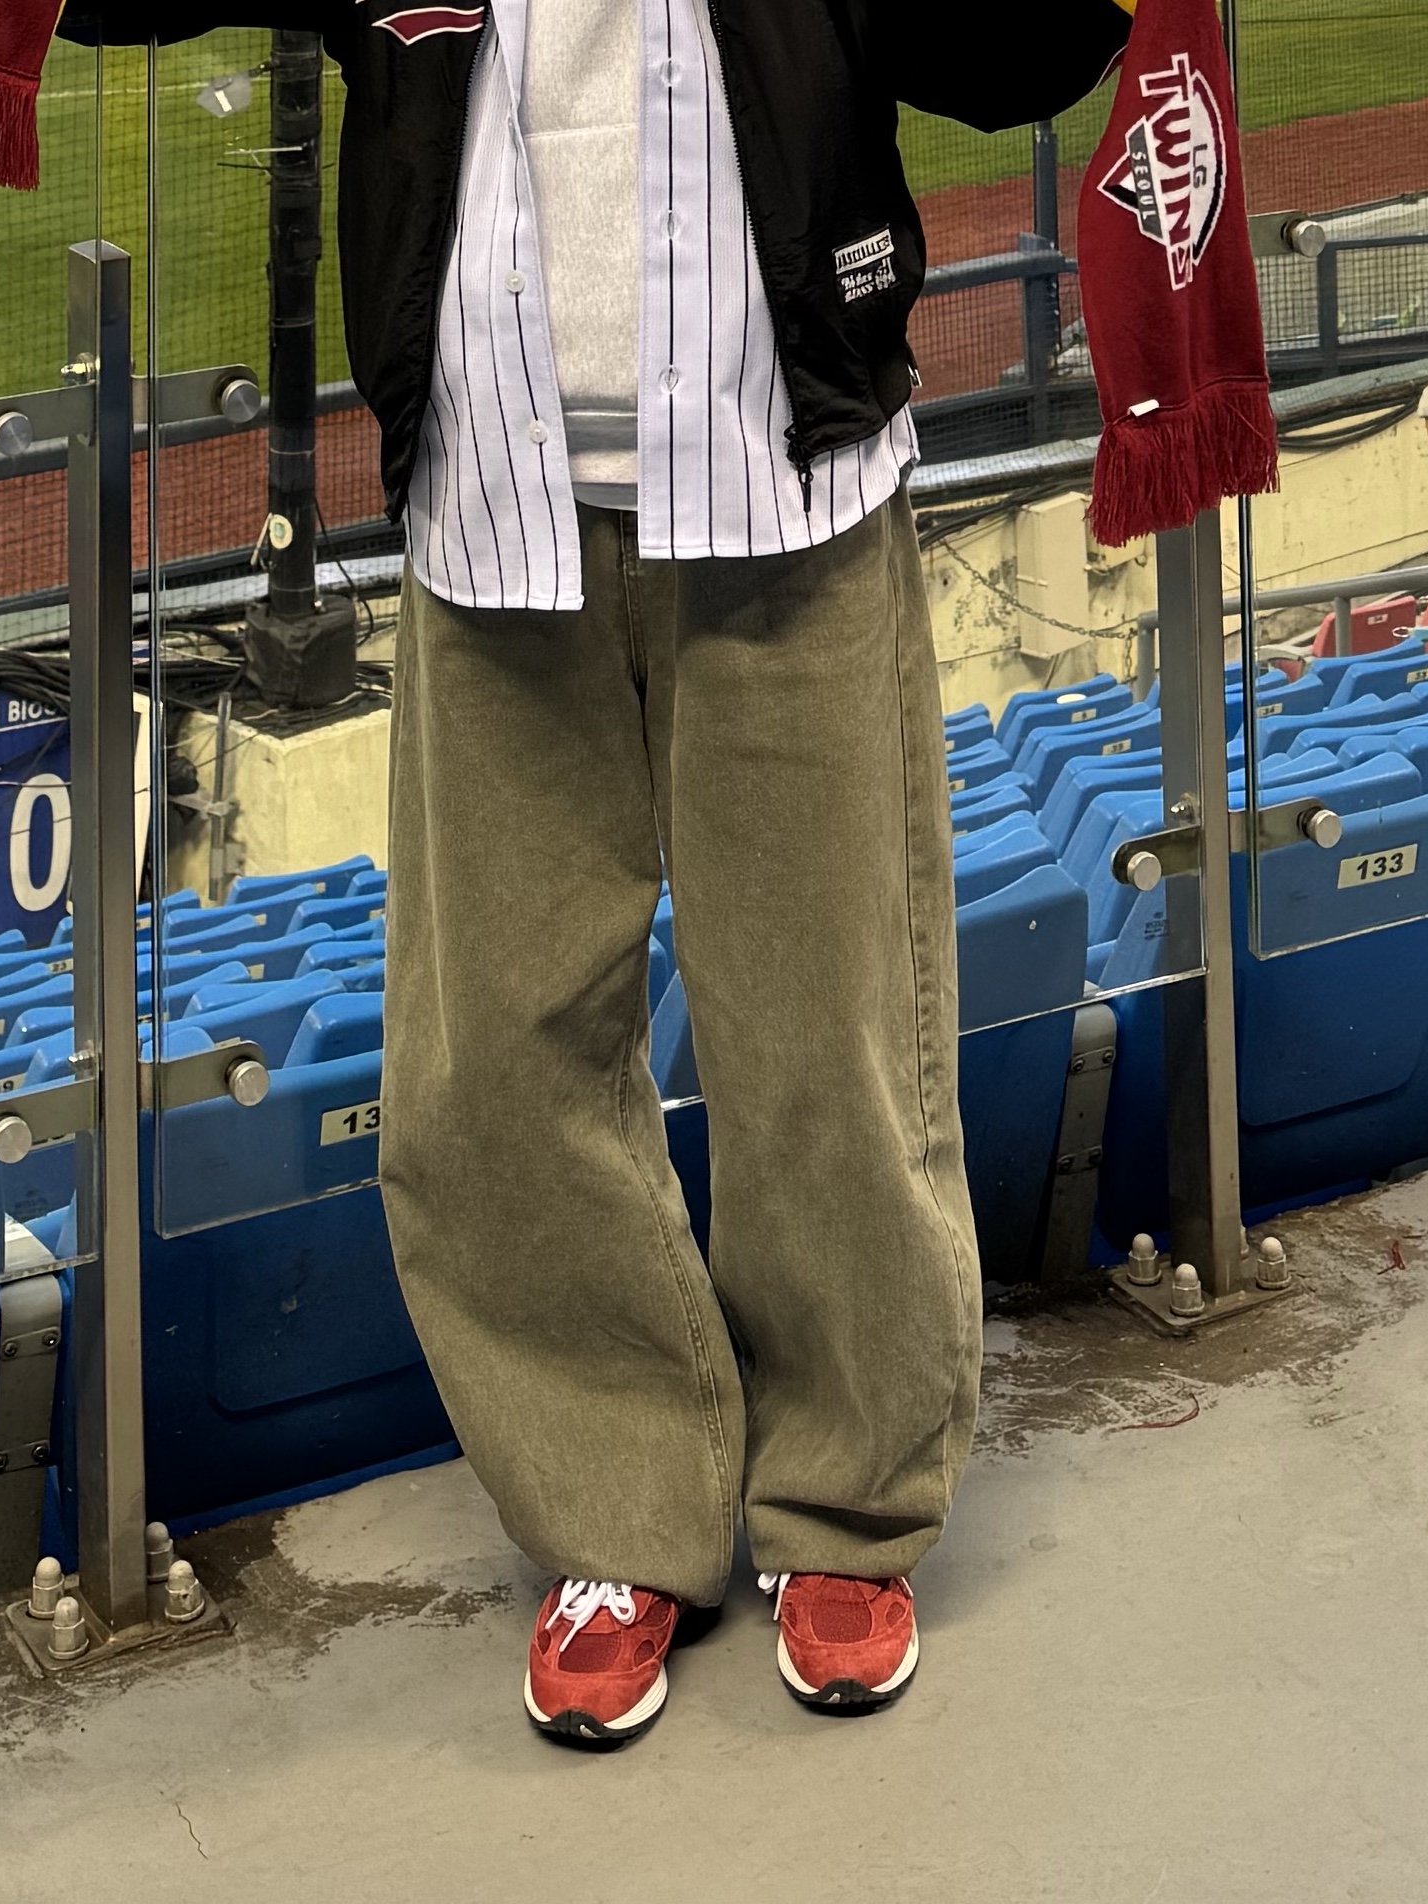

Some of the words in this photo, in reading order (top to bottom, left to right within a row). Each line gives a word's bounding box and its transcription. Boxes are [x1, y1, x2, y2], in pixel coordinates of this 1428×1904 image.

[1131, 150, 1157, 221] SEOUL
[1138, 52, 1194, 291] TWINS
[1193, 143, 1208, 189] LG
[1355, 850, 1405, 881] 133
[342, 1106, 381, 1135] 13
